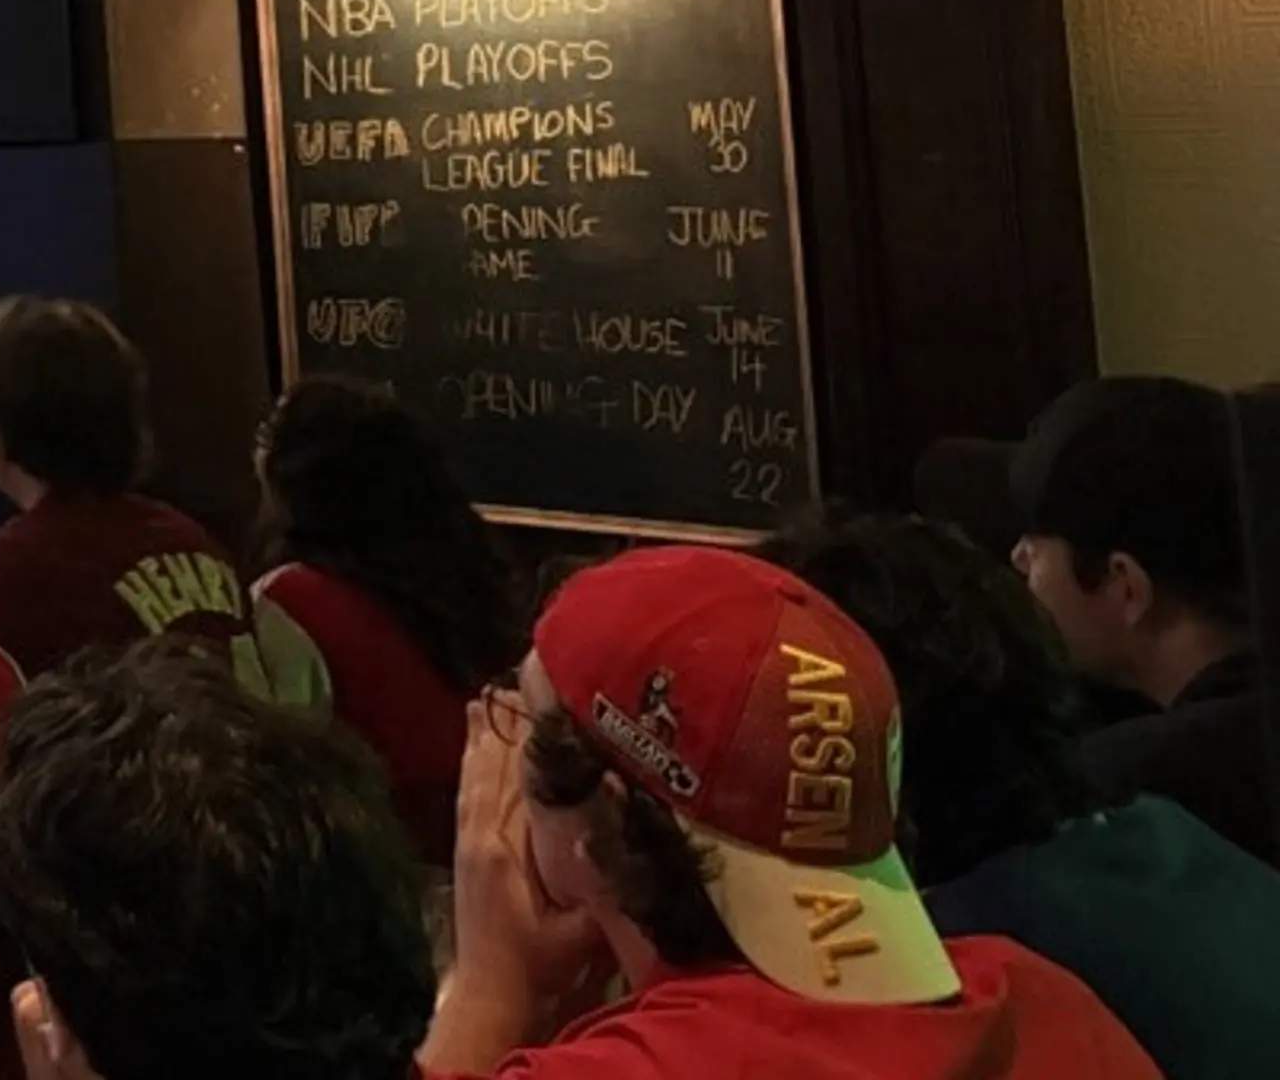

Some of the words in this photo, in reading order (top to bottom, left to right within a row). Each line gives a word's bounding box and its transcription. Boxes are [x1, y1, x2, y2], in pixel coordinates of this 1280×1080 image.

[302, 54, 394, 99] NHL
[415, 40, 614, 90] PLAYOFFS
[295, 117, 410, 165] UEFA
[420, 101, 616, 151] CHAMPIONS
[689, 98, 757, 147] MAY
[422, 150, 552, 191] LEAGUE
[567, 145, 650, 185] FINAL
[708, 139, 750, 174] 30
[460, 202, 601, 245] PENING
[667, 205, 770, 246] JUNE
[466, 249, 539, 281] AME
[715, 250, 734, 280] 11
[307, 296, 406, 349] UFC
[572, 308, 688, 358] HOUSE
[699, 305, 782, 347] JUNE
[729, 346, 767, 391] 14
[632, 379, 697, 433] DAY
[719, 404, 798, 451] AUG
[728, 458, 783, 507] 22
[779, 642, 857, 851] ARSEN
[793, 888, 880, 986] AL
